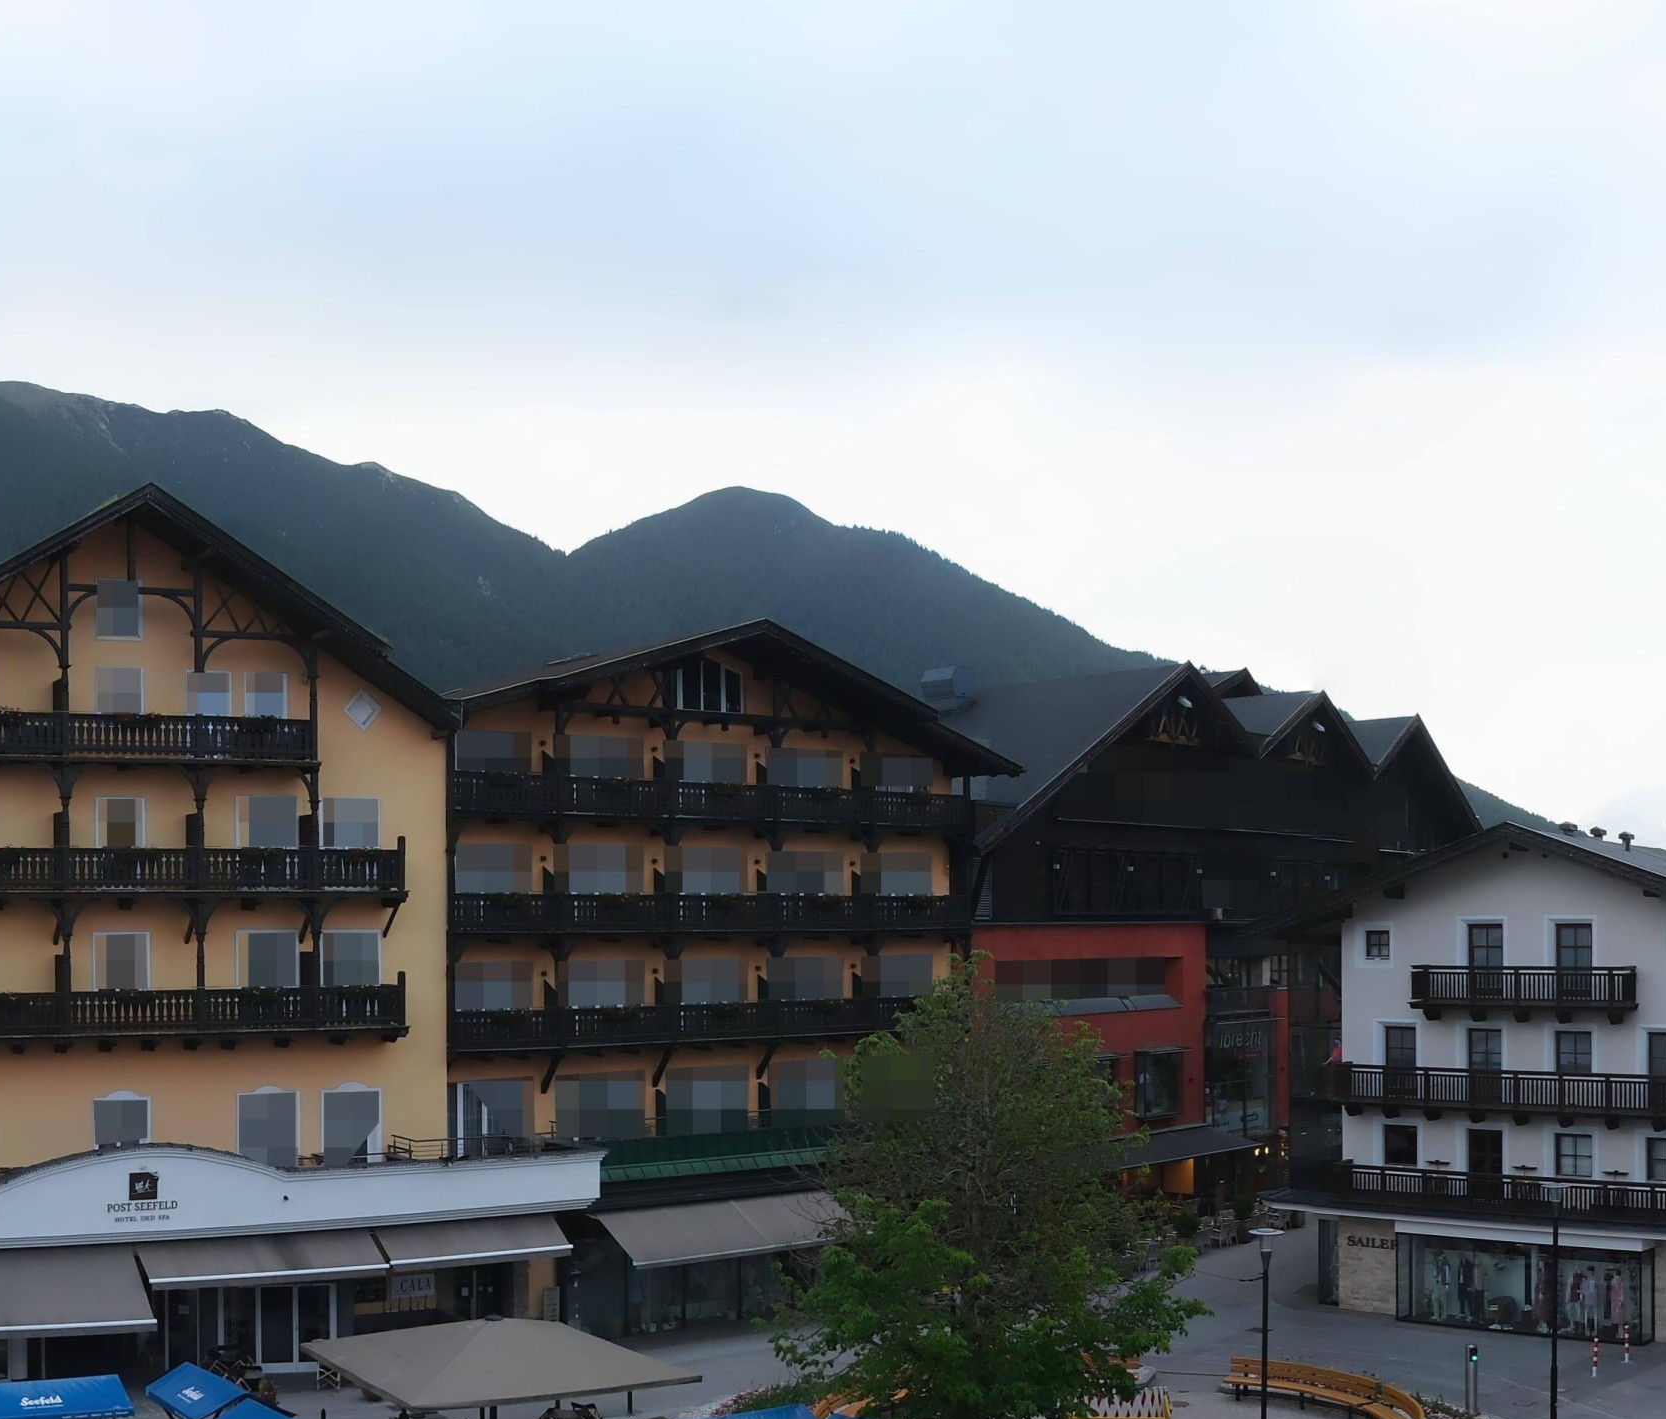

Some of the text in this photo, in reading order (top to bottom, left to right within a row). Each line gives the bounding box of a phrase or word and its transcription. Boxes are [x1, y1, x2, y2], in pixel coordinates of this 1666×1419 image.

[107, 1200, 178, 1213] POST SEEFELD
[20, 1394, 63, 1407] Seefeld
